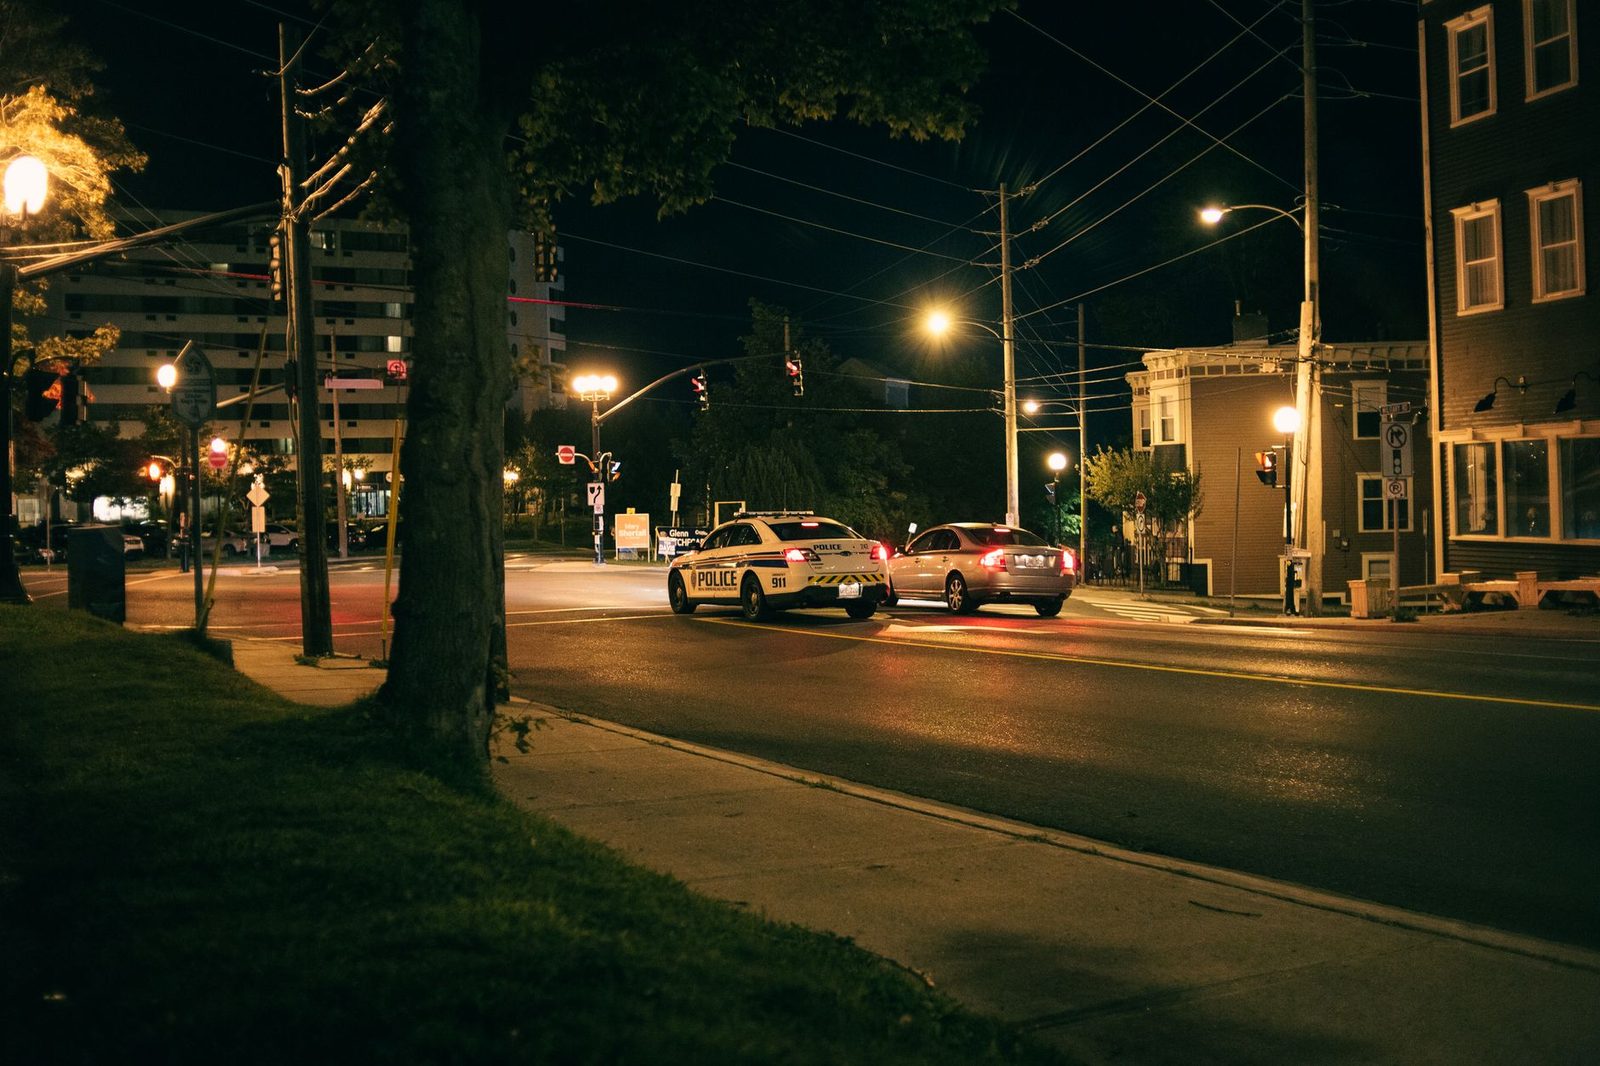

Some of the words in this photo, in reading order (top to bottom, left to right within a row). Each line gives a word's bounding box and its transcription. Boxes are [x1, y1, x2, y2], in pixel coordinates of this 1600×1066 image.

[669, 529, 689, 537] Glenn
[698, 571, 737, 586] POLICE
[772, 577, 786, 588] 911
